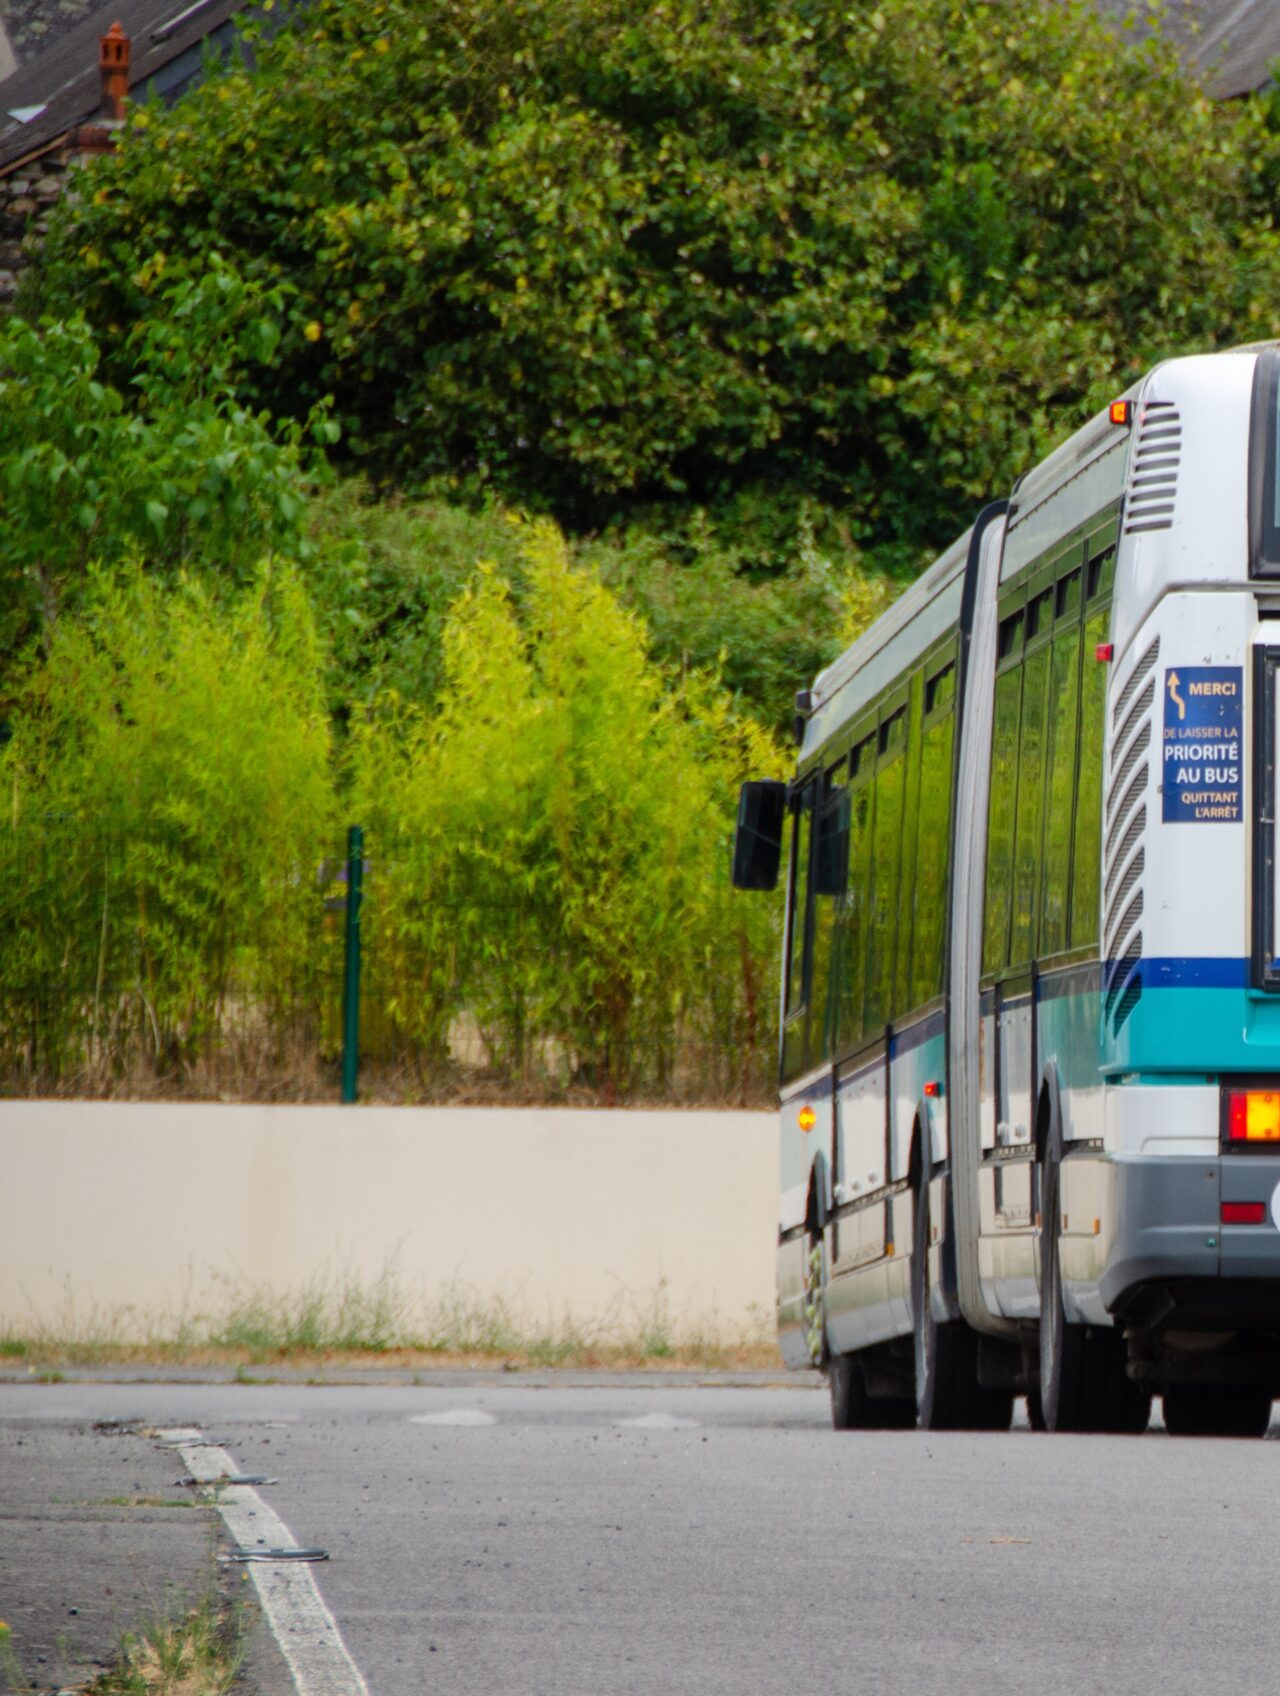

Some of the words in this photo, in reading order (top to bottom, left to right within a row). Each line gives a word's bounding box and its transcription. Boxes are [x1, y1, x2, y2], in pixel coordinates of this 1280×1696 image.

[1189, 682, 1236, 696] MERCI
[1164, 728, 1176, 739] DE
[1179, 727, 1221, 738] LAISSER
[1224, 727, 1238, 738] LA
[1165, 742, 1238, 761] PRIORITÉ
[1176, 768, 1200, 784] AU
[1205, 767, 1239, 784] BUS
[1181, 792, 1238, 804] QUITTANT
[1195, 806, 1238, 818] L'ARRÊT
